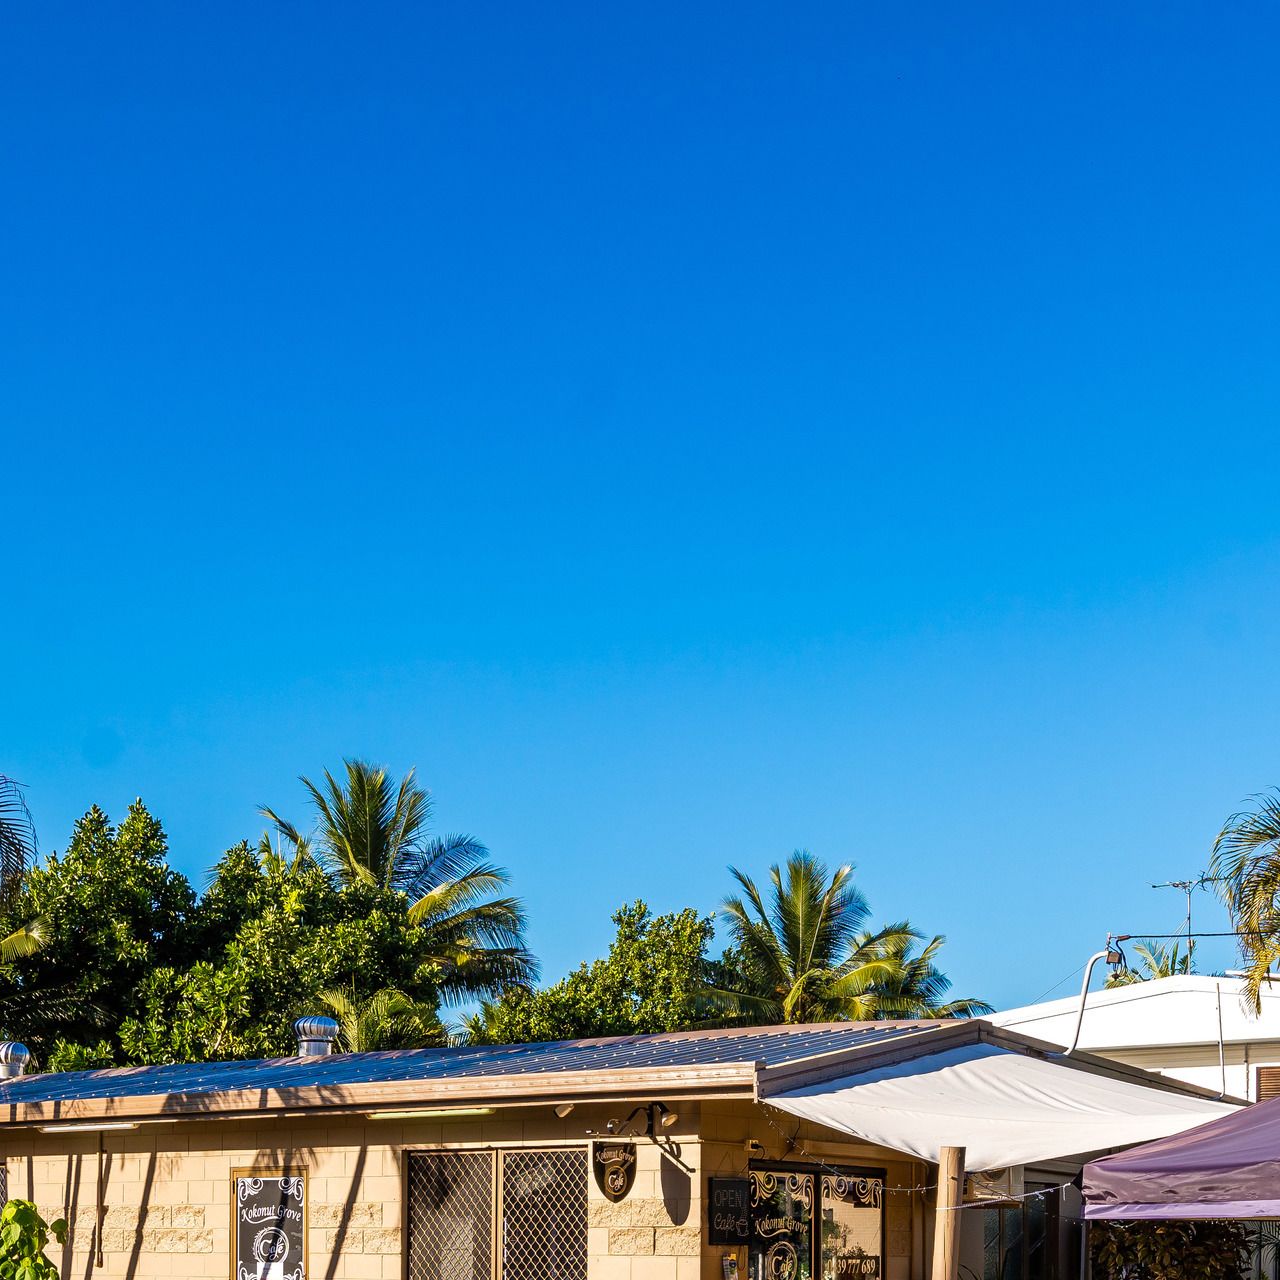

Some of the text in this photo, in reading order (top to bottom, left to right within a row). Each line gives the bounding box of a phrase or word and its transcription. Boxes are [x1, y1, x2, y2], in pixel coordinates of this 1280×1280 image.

[619, 1149, 634, 1163] Grove
[714, 1189, 742, 1207] OPEN
[241, 1203, 301, 1224] Kokonut Grove
[754, 1213, 808, 1237] Kokonut Grove
[827, 1259, 876, 1274] 039 777 689
